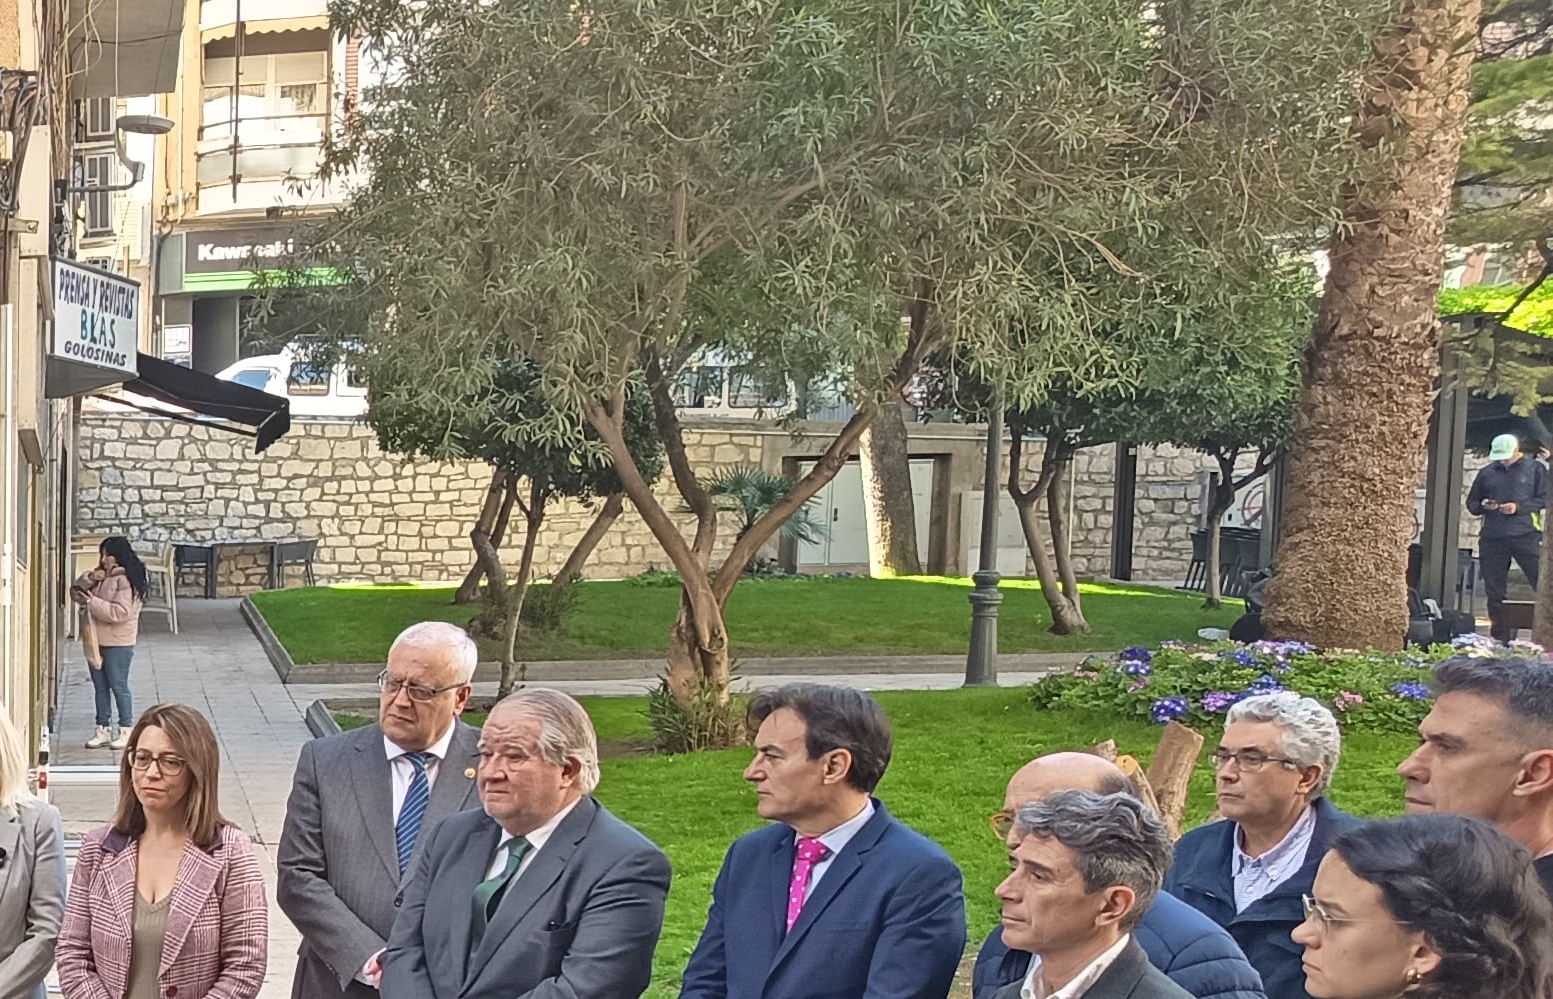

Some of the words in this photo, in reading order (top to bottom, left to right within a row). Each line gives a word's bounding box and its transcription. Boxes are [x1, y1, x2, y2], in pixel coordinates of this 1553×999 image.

[59, 267, 90, 308] PRENSA
[92, 277, 98, 310] Y
[99, 280, 135, 320] REVISTAS
[80, 308, 116, 350] BLAS
[64, 340, 127, 367] GOLOSINAS
